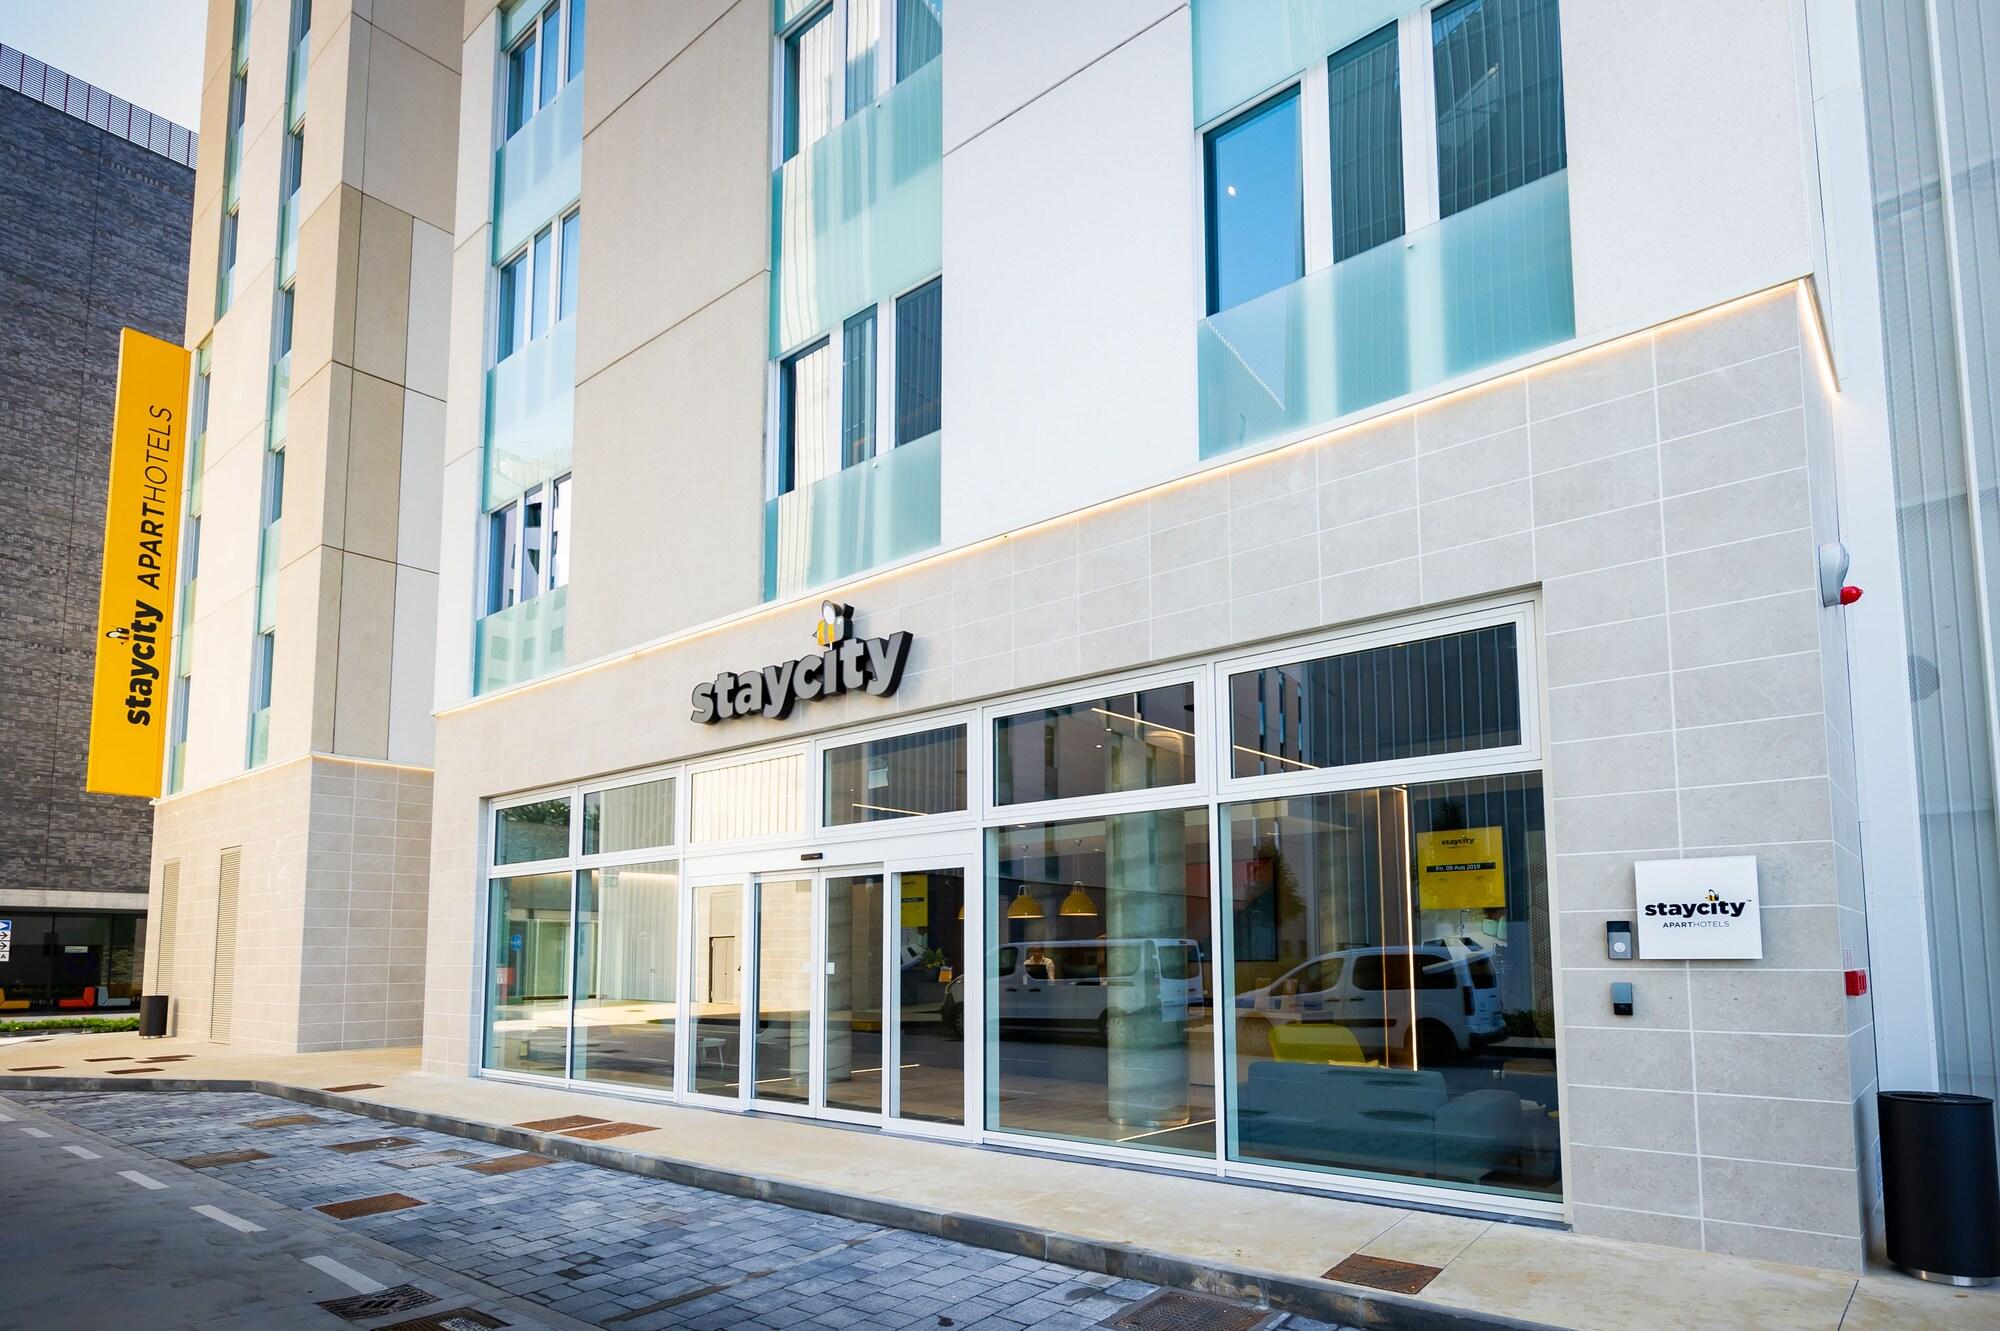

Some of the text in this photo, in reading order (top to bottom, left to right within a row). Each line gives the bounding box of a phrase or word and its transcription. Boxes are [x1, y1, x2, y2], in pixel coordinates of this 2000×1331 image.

[126, 405, 173, 727] staycity APARTHOTELS
[690, 631, 914, 725] staycity
[1645, 901, 1746, 918] staycity
[1663, 920, 1730, 928] APARTHOTELS
